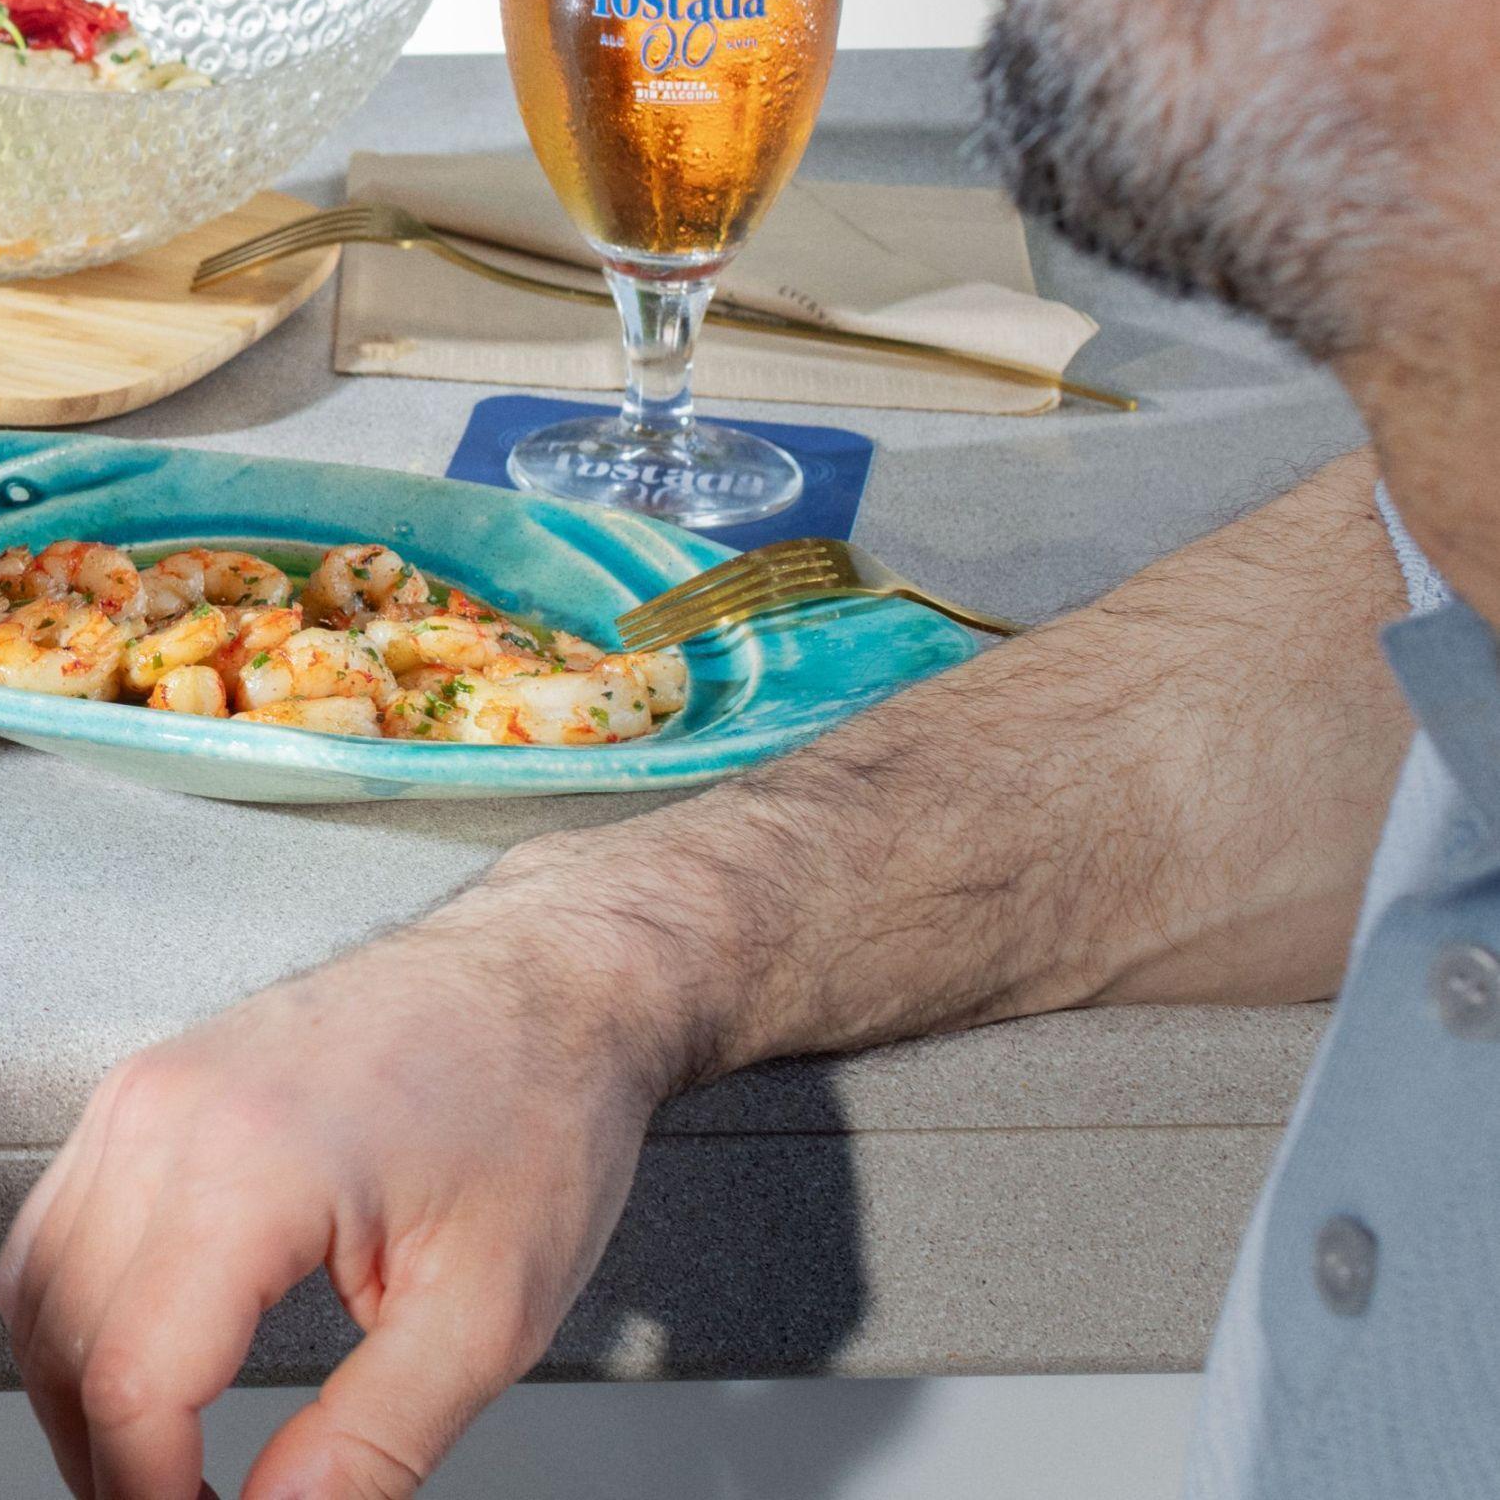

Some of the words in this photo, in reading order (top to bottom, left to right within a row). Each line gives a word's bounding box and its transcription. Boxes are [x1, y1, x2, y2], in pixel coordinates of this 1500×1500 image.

[648, 80, 707, 91] CERVEZA
[635, 88, 659, 100] SIN
[662, 89, 719, 101] ALCOHOL
